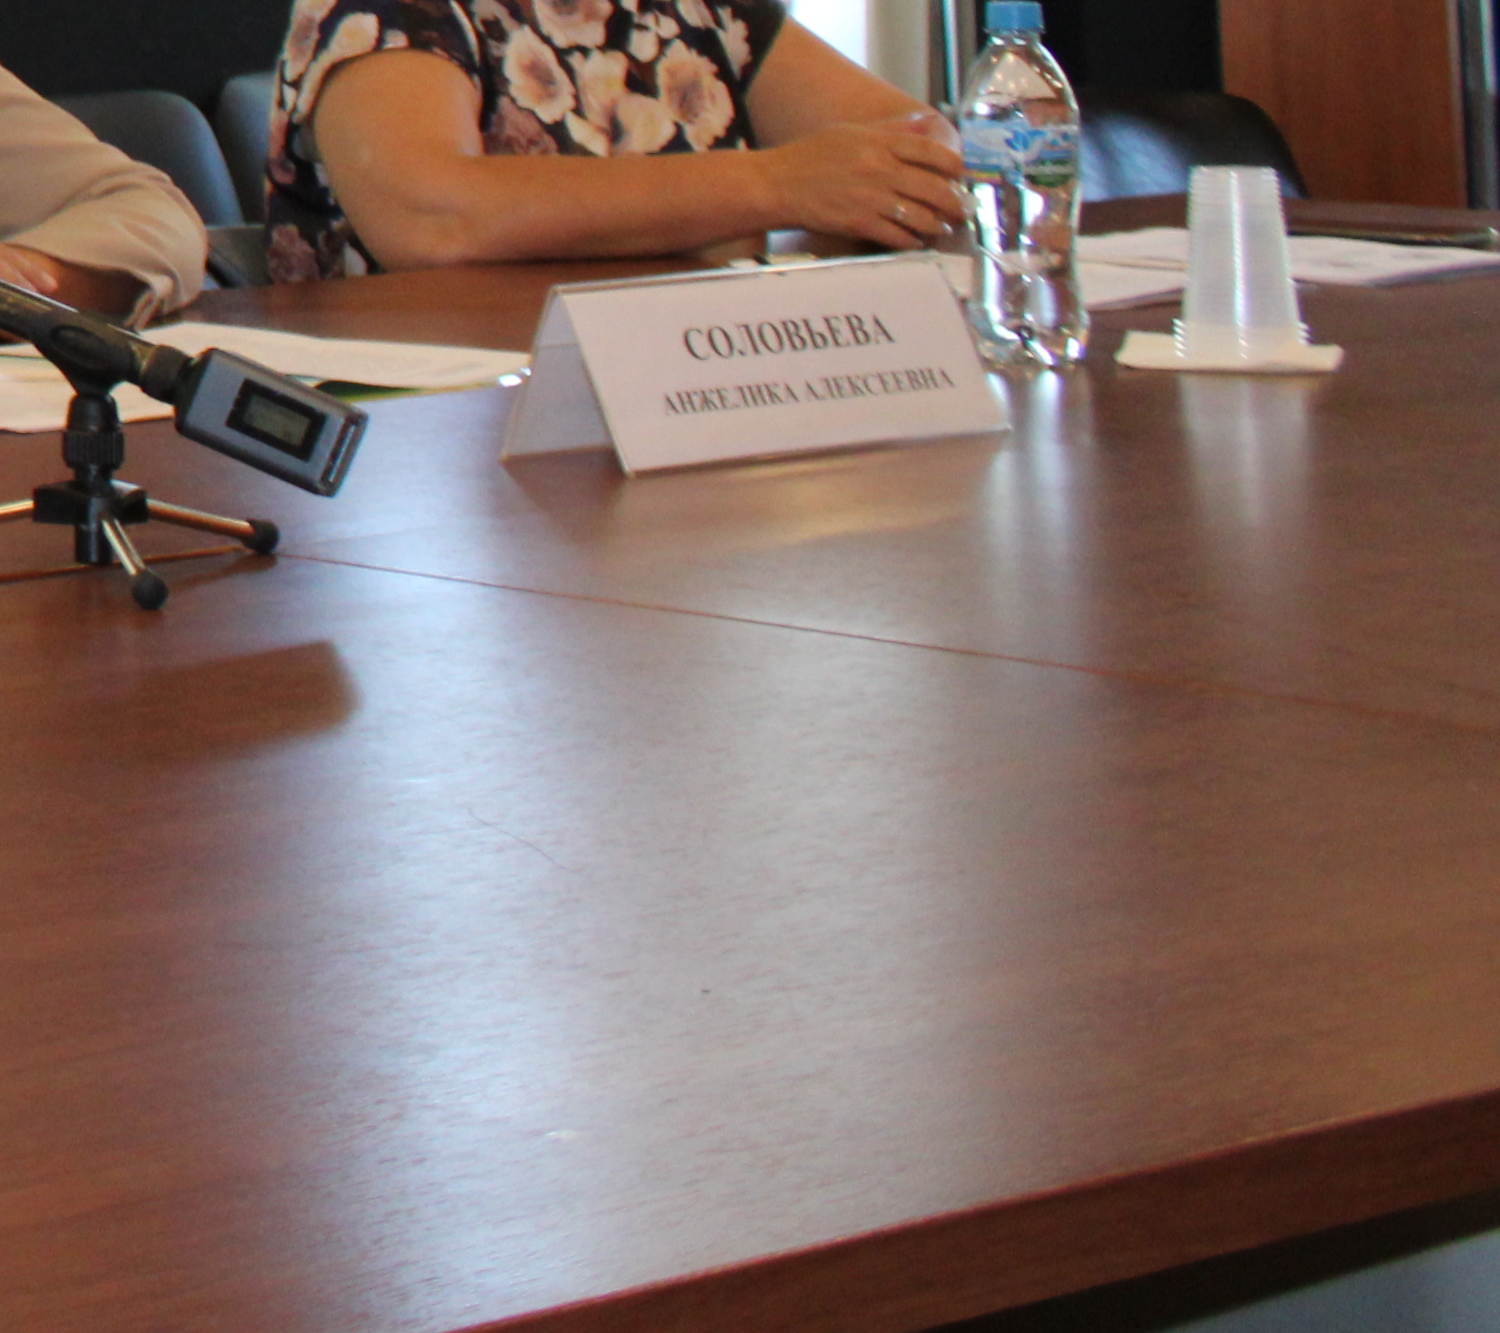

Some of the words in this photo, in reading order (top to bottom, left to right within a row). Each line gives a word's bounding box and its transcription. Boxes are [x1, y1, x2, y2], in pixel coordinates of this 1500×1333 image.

[683, 313, 897, 361] СОЛОВЬЕВА
[663, 383, 800, 416] АНЖЕЛИКА
[805, 367, 956, 401] АЛЕКСЕЕВНА
